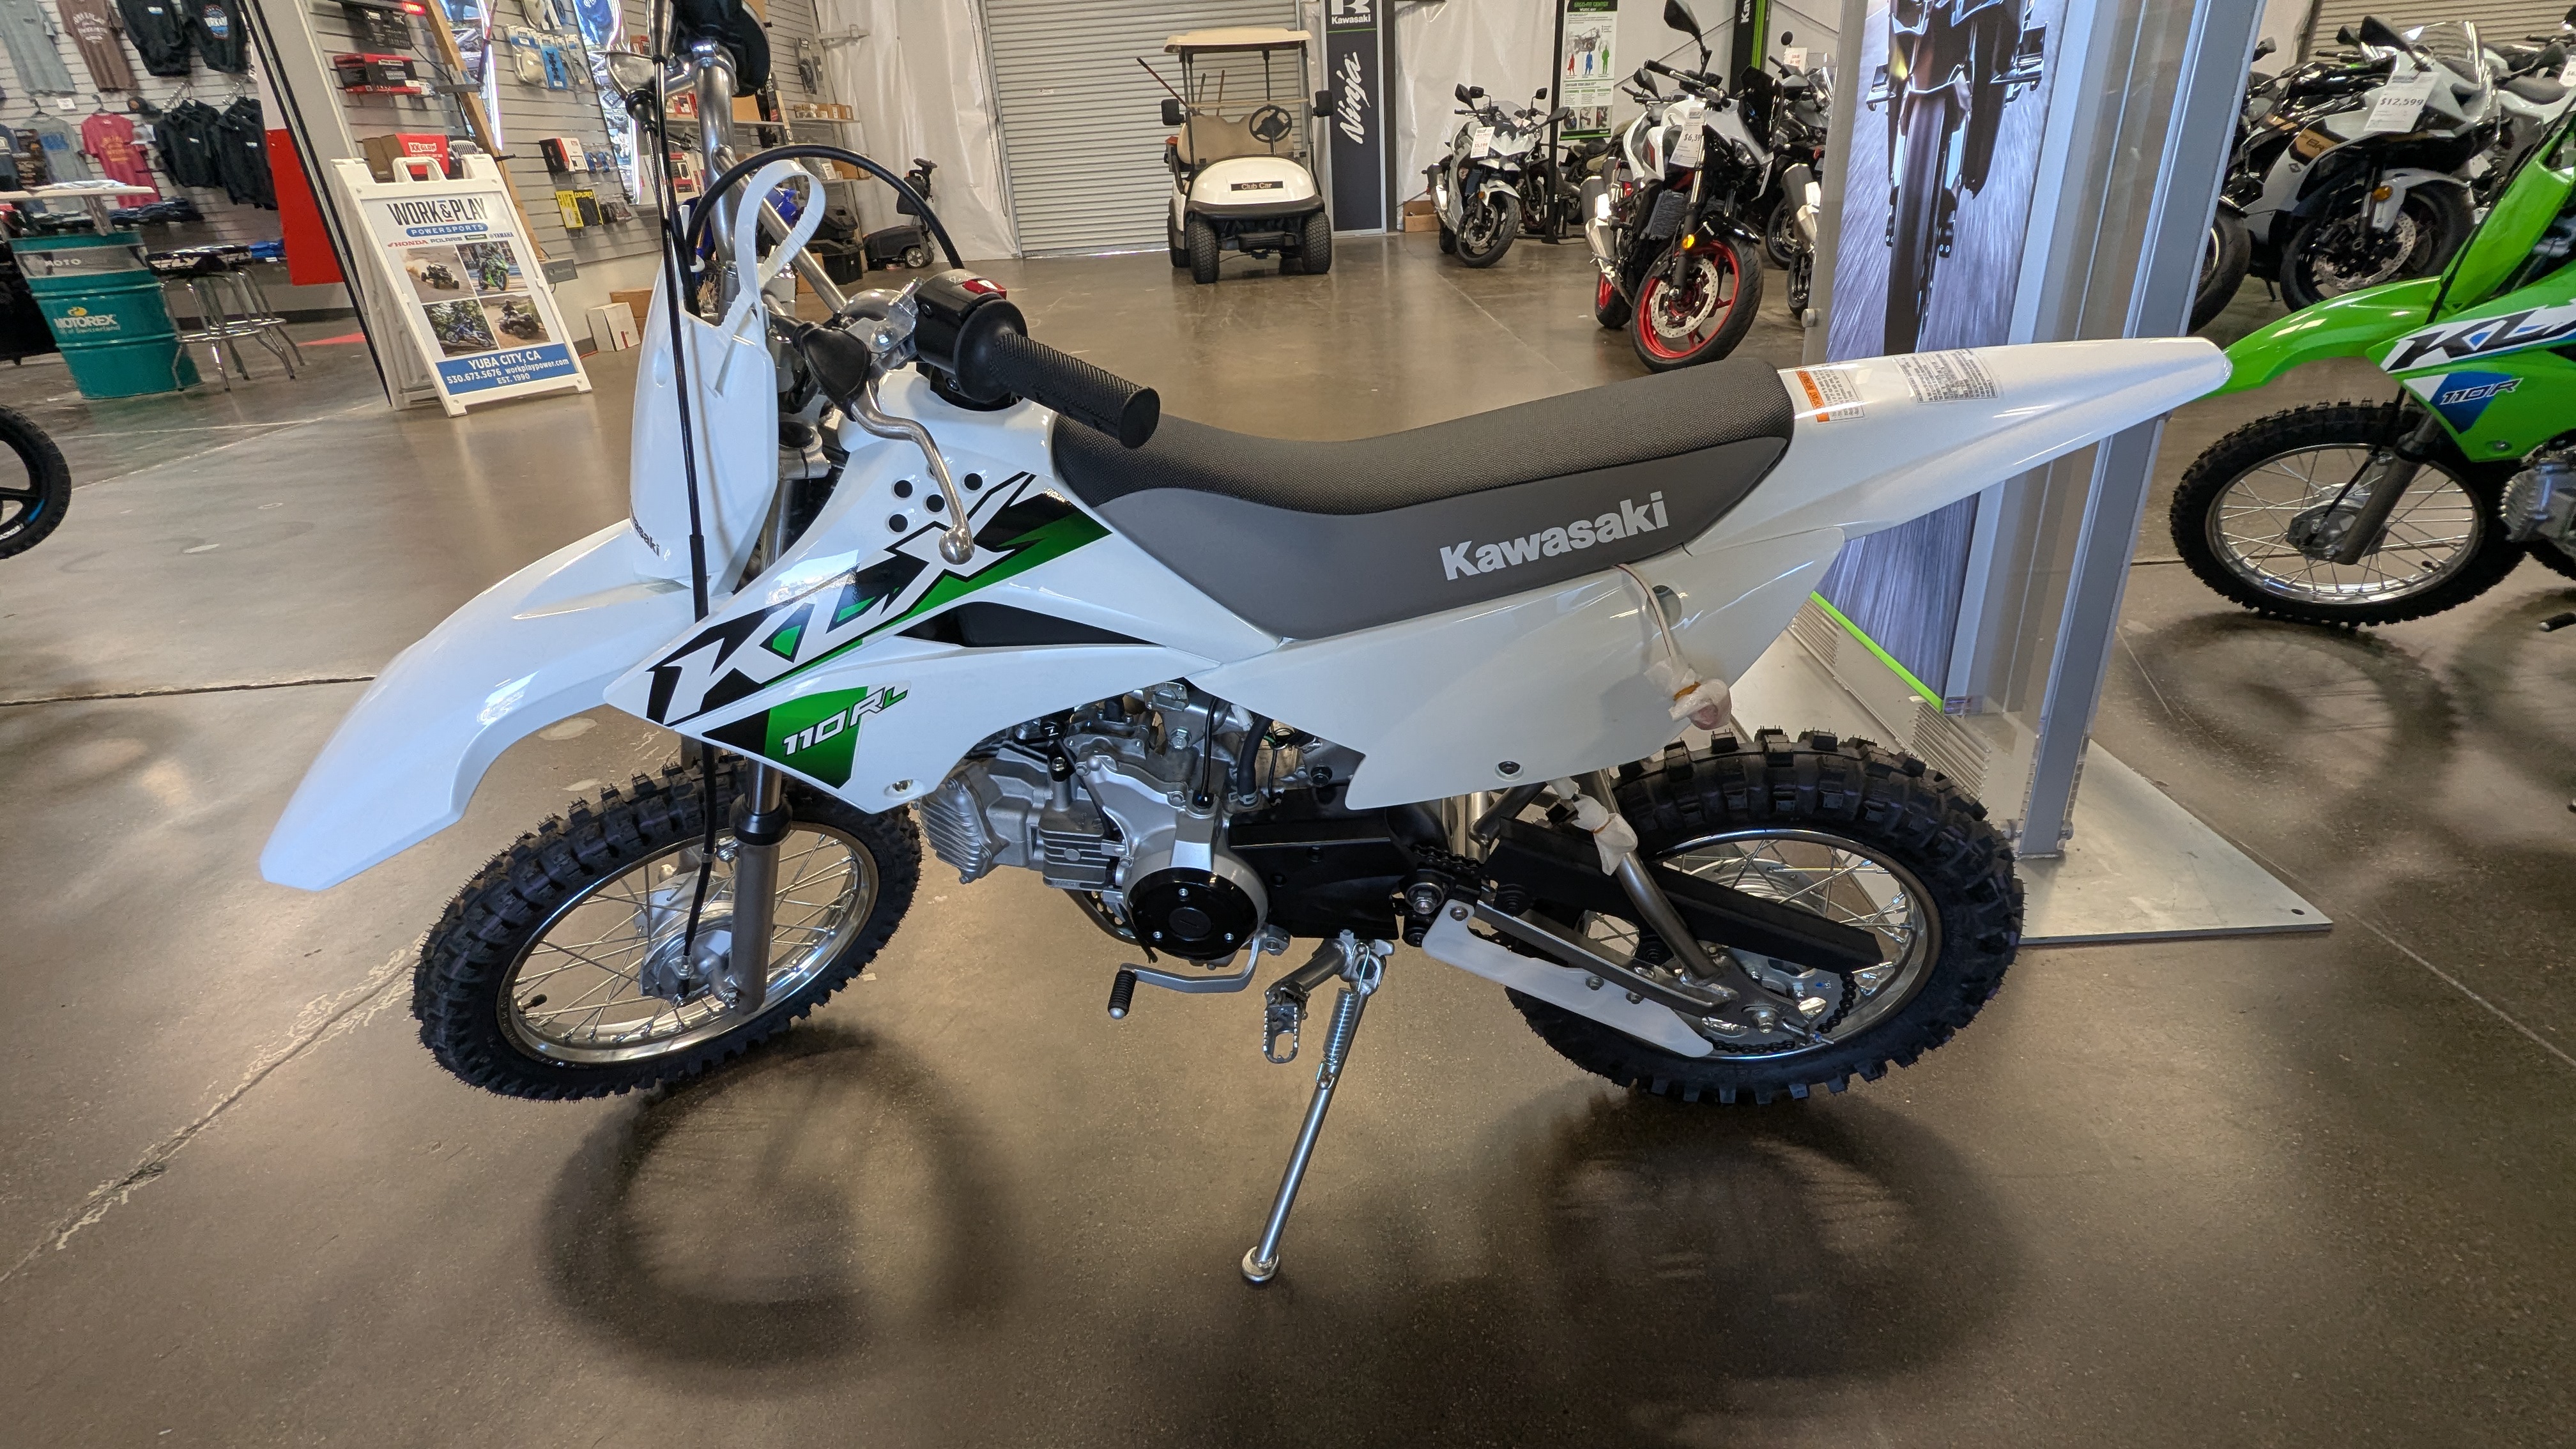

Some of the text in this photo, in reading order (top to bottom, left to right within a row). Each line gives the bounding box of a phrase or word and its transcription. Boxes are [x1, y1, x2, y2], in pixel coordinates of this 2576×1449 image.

[1331, 14, 1371, 25] Kawasaki
[1336, 51, 1371, 144] Ninja
[2379, 97, 2424, 107] $12,599
[411, 224, 484, 236] POWERSPORTS
[392, 239, 429, 247] HONDA
[54, 314, 116, 329] MOTOREX
[468, 350, 542, 370] YUBA CITY, CA
[446, 358, 569, 384] 530.673.5676 workplaypower.com
[496, 373, 530, 385] EST. 1990
[2439, 378, 2524, 405] 110R
[1439, 491, 1669, 581] Kawasaki
